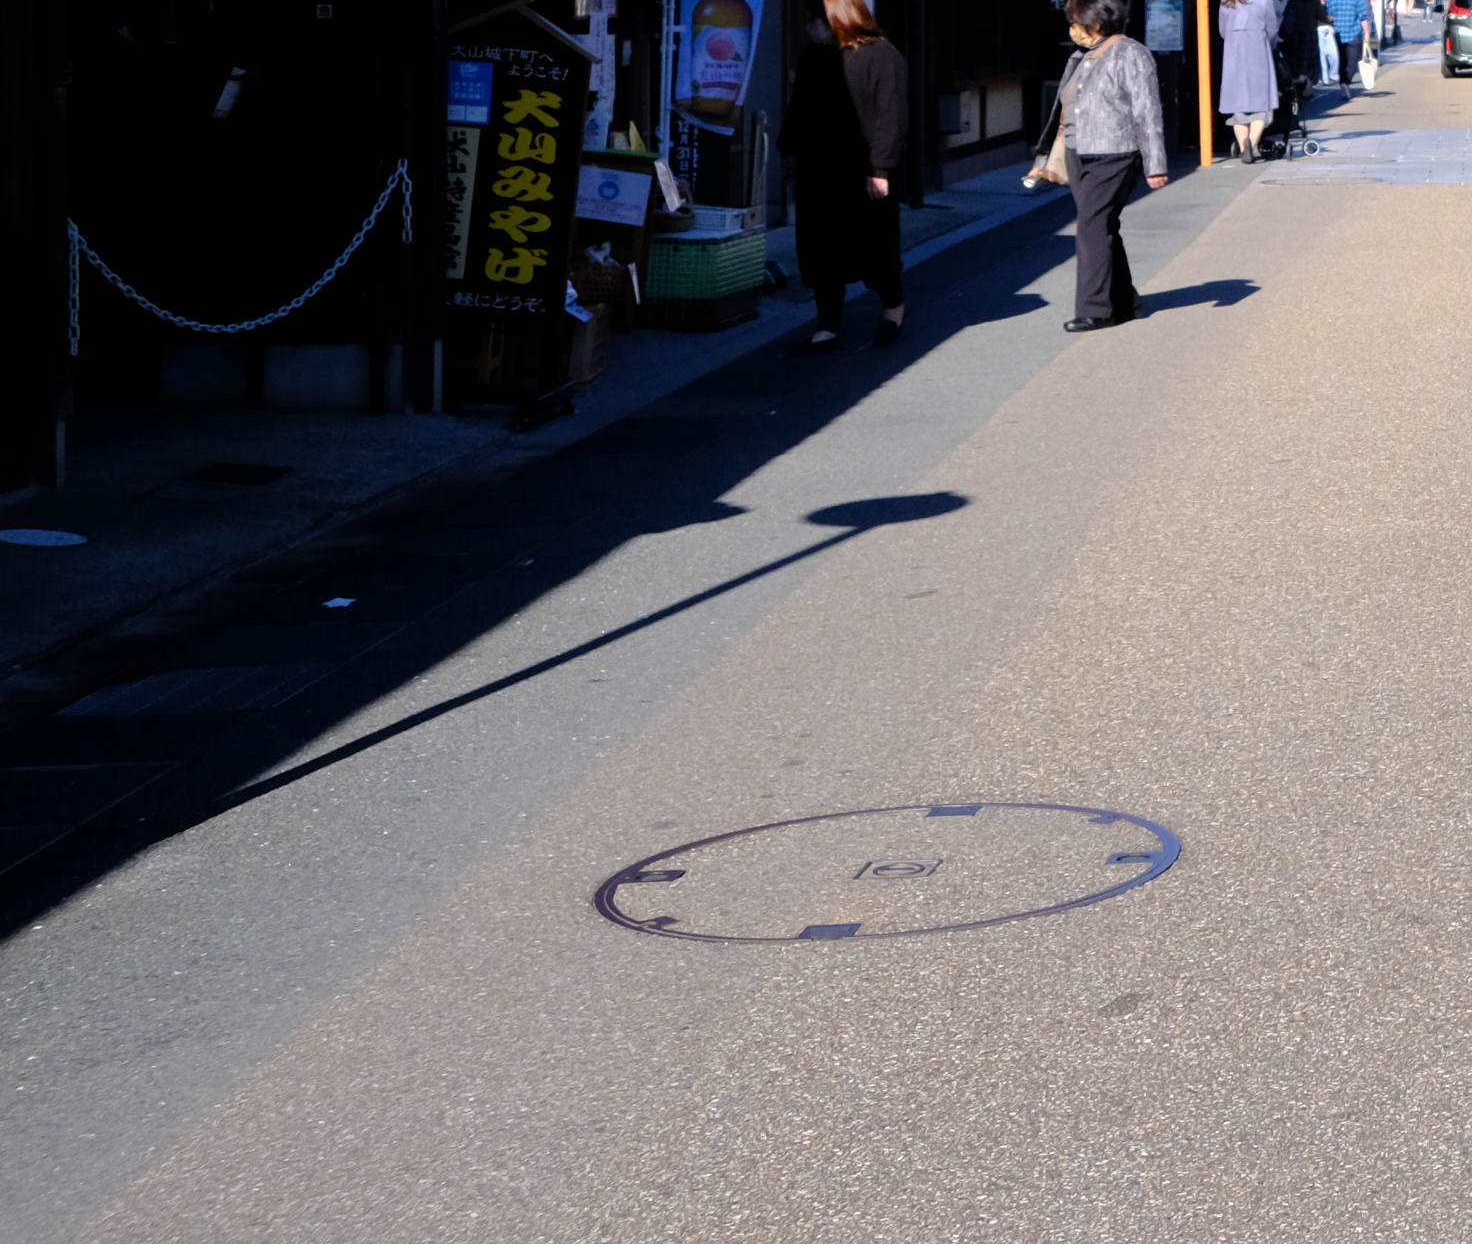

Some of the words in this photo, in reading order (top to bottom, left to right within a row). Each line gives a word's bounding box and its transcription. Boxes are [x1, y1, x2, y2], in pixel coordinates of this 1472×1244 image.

[485, 89, 563, 284] 犬山みやげ
